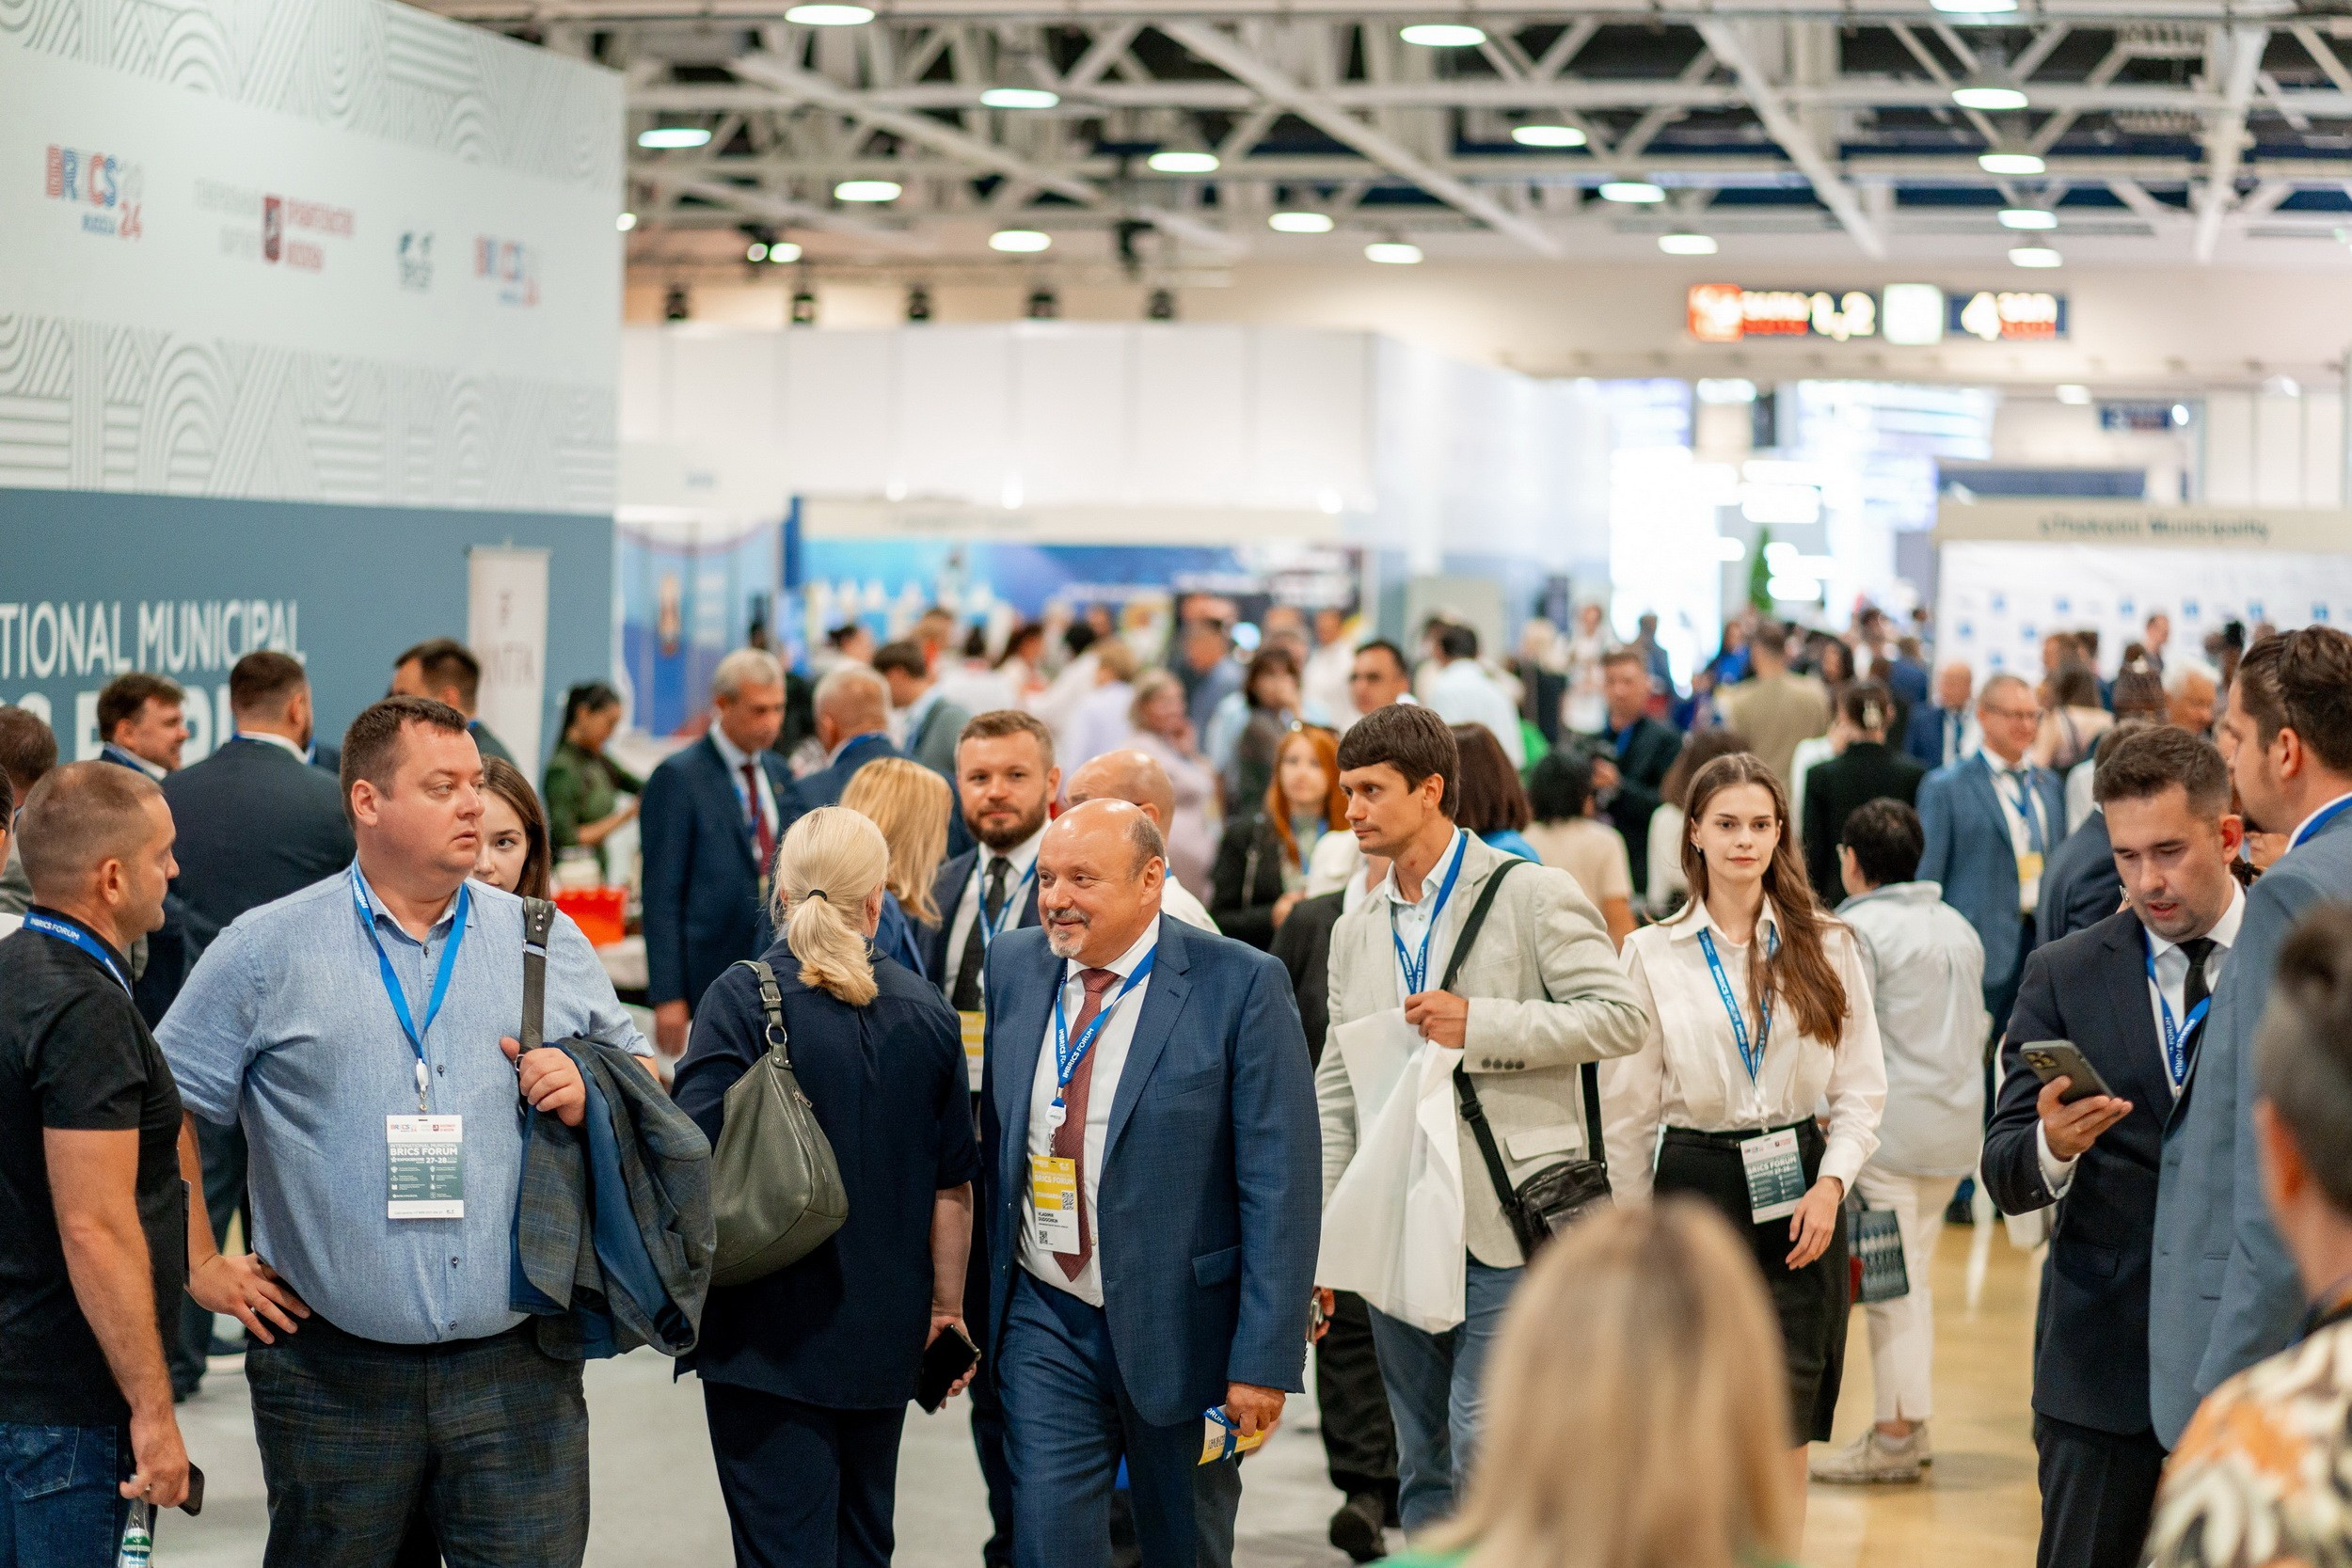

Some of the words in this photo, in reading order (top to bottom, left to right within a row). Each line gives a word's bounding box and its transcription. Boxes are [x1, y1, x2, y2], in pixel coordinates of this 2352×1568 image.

[137, 598, 306, 673] MUNICIPAL
[52, 925, 80, 940] FORUM
[1712, 964, 1730, 996] IMBRICS
[1724, 994, 1740, 1023] FORUM
[1058, 1028, 1067, 1056] IMBRICS
[2176, 1018, 2197, 1048] IMBRICS
[1062, 1052, 1080, 1078] IMBRICS
[1077, 1027, 1095, 1053] FORUM
[2174, 1049, 2184, 1077] FORUM
[1769, 1155, 1797, 1169] FORUM
[1053, 1176, 1074, 1185] FORUM
